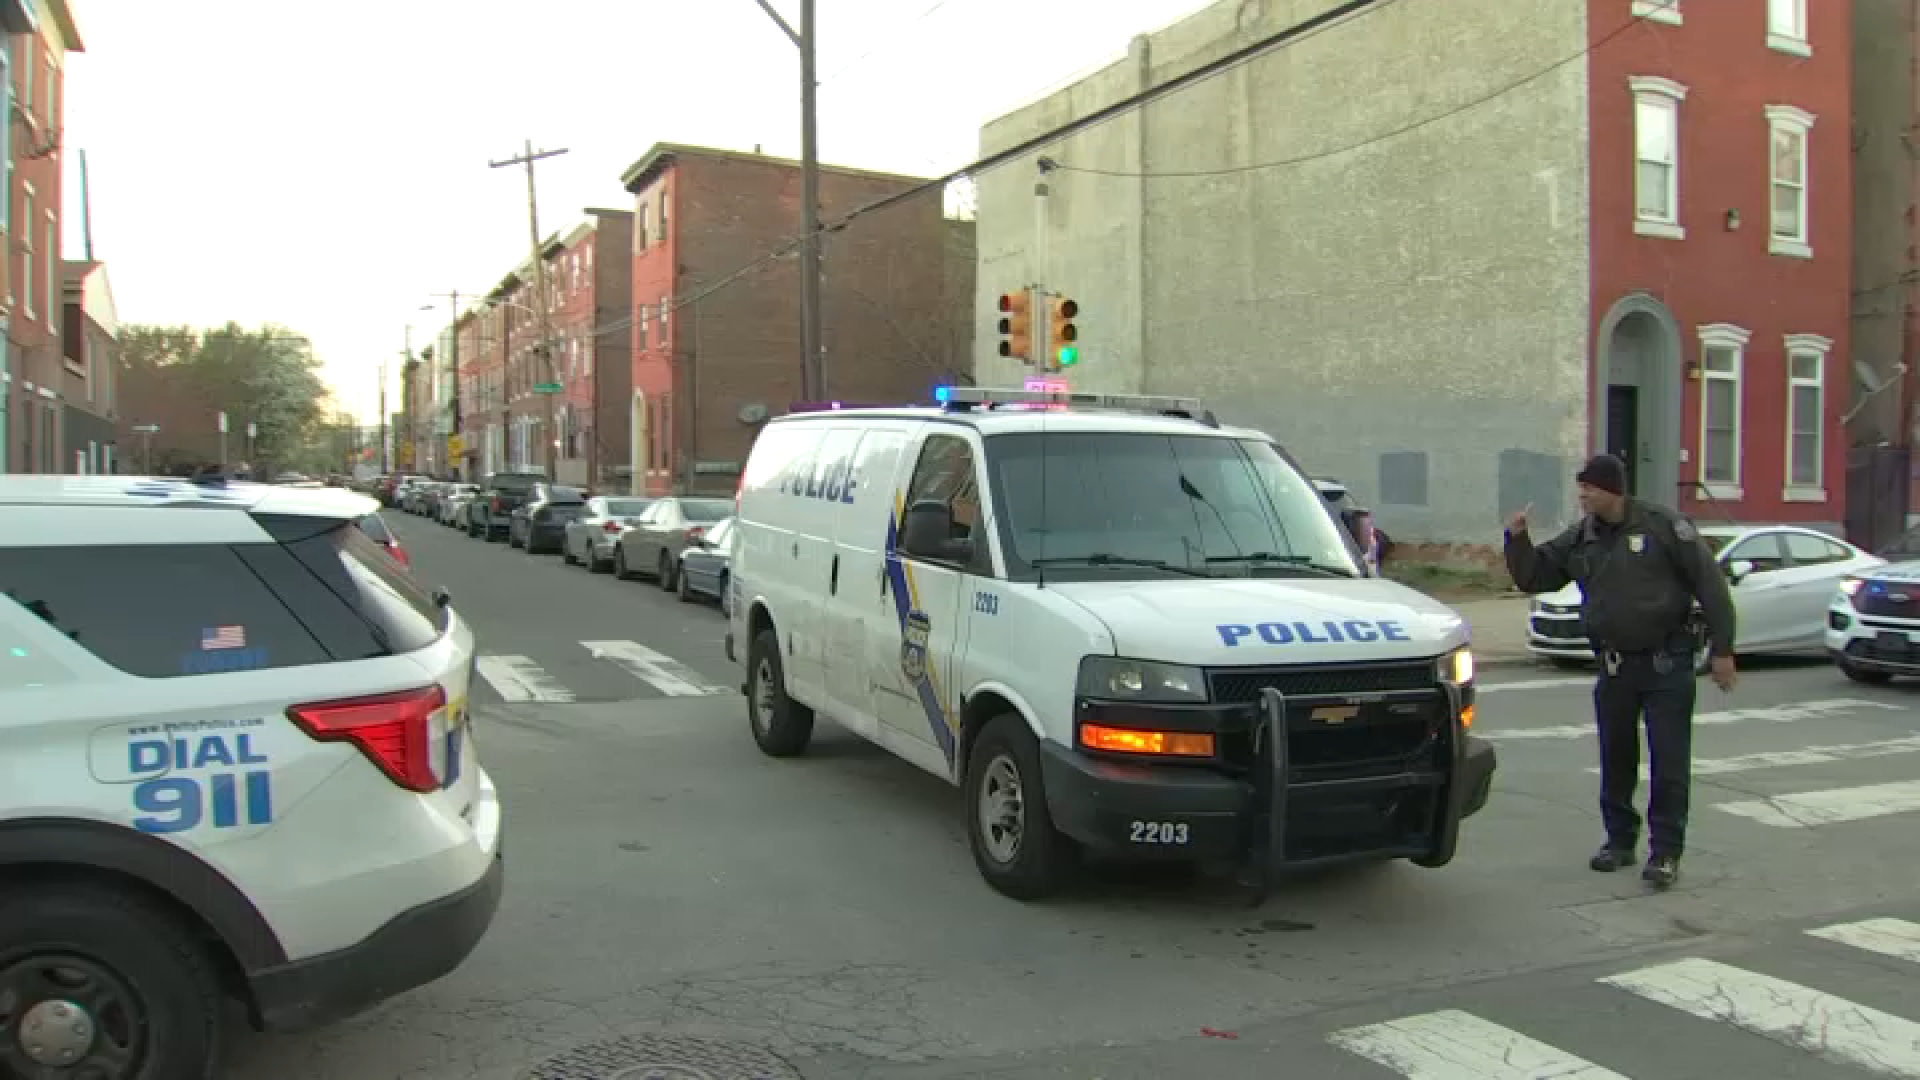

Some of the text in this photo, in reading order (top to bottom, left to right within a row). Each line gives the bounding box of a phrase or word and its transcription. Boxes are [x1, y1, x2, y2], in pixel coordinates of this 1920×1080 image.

[976, 592, 997, 614] 2203
[1216, 620, 1411, 646] POLICE
[129, 734, 267, 772] DIAL
[133, 771, 272, 832] 911
[1130, 821, 1188, 844] 2203
